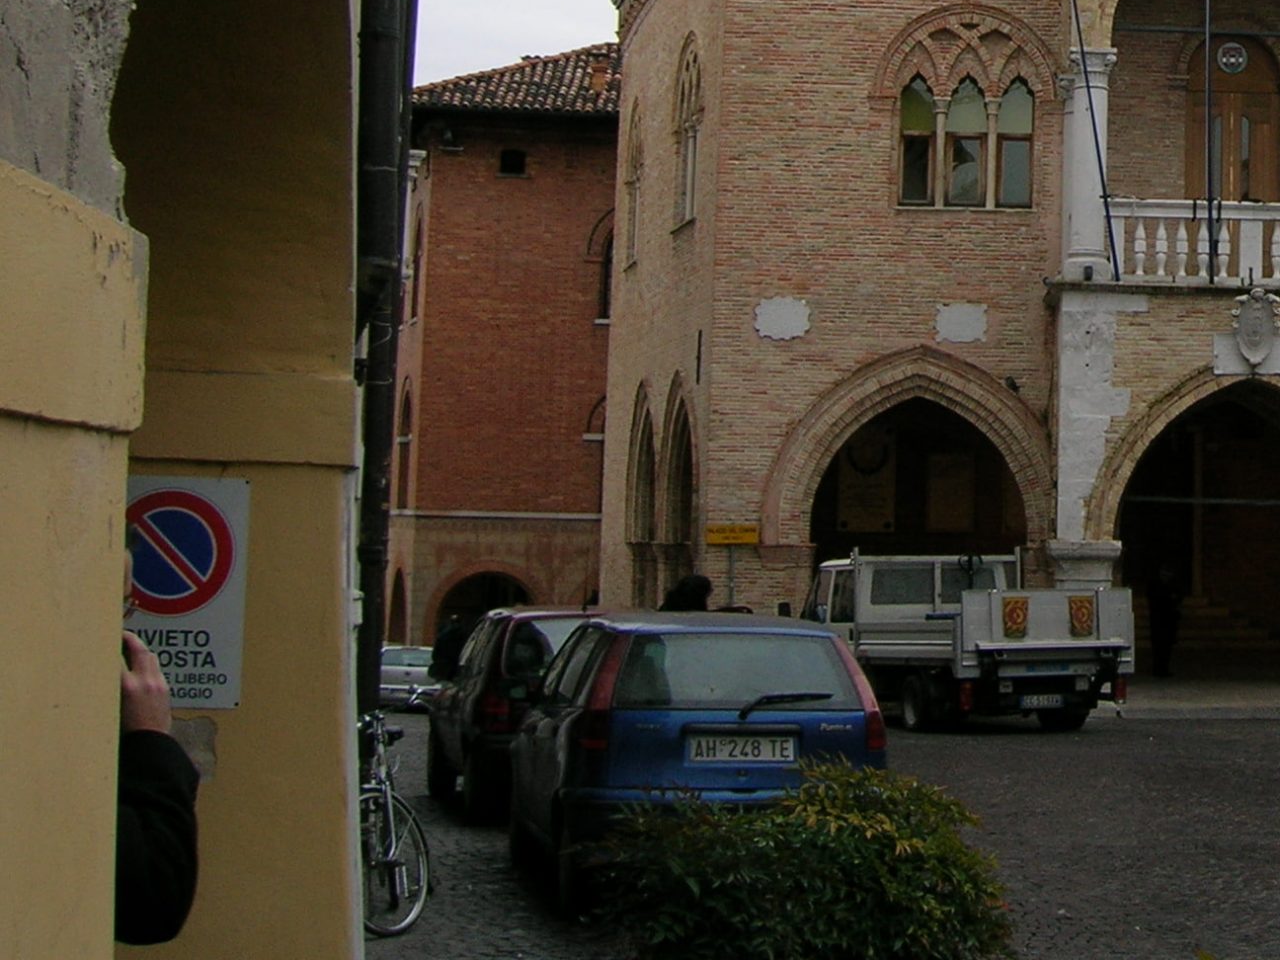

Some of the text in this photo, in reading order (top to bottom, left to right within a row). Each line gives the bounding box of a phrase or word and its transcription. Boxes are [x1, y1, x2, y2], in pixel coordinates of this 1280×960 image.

[125, 629, 210, 647] IVIETO
[151, 650, 216, 668] OSTA
[175, 673, 228, 685] LIBERO
